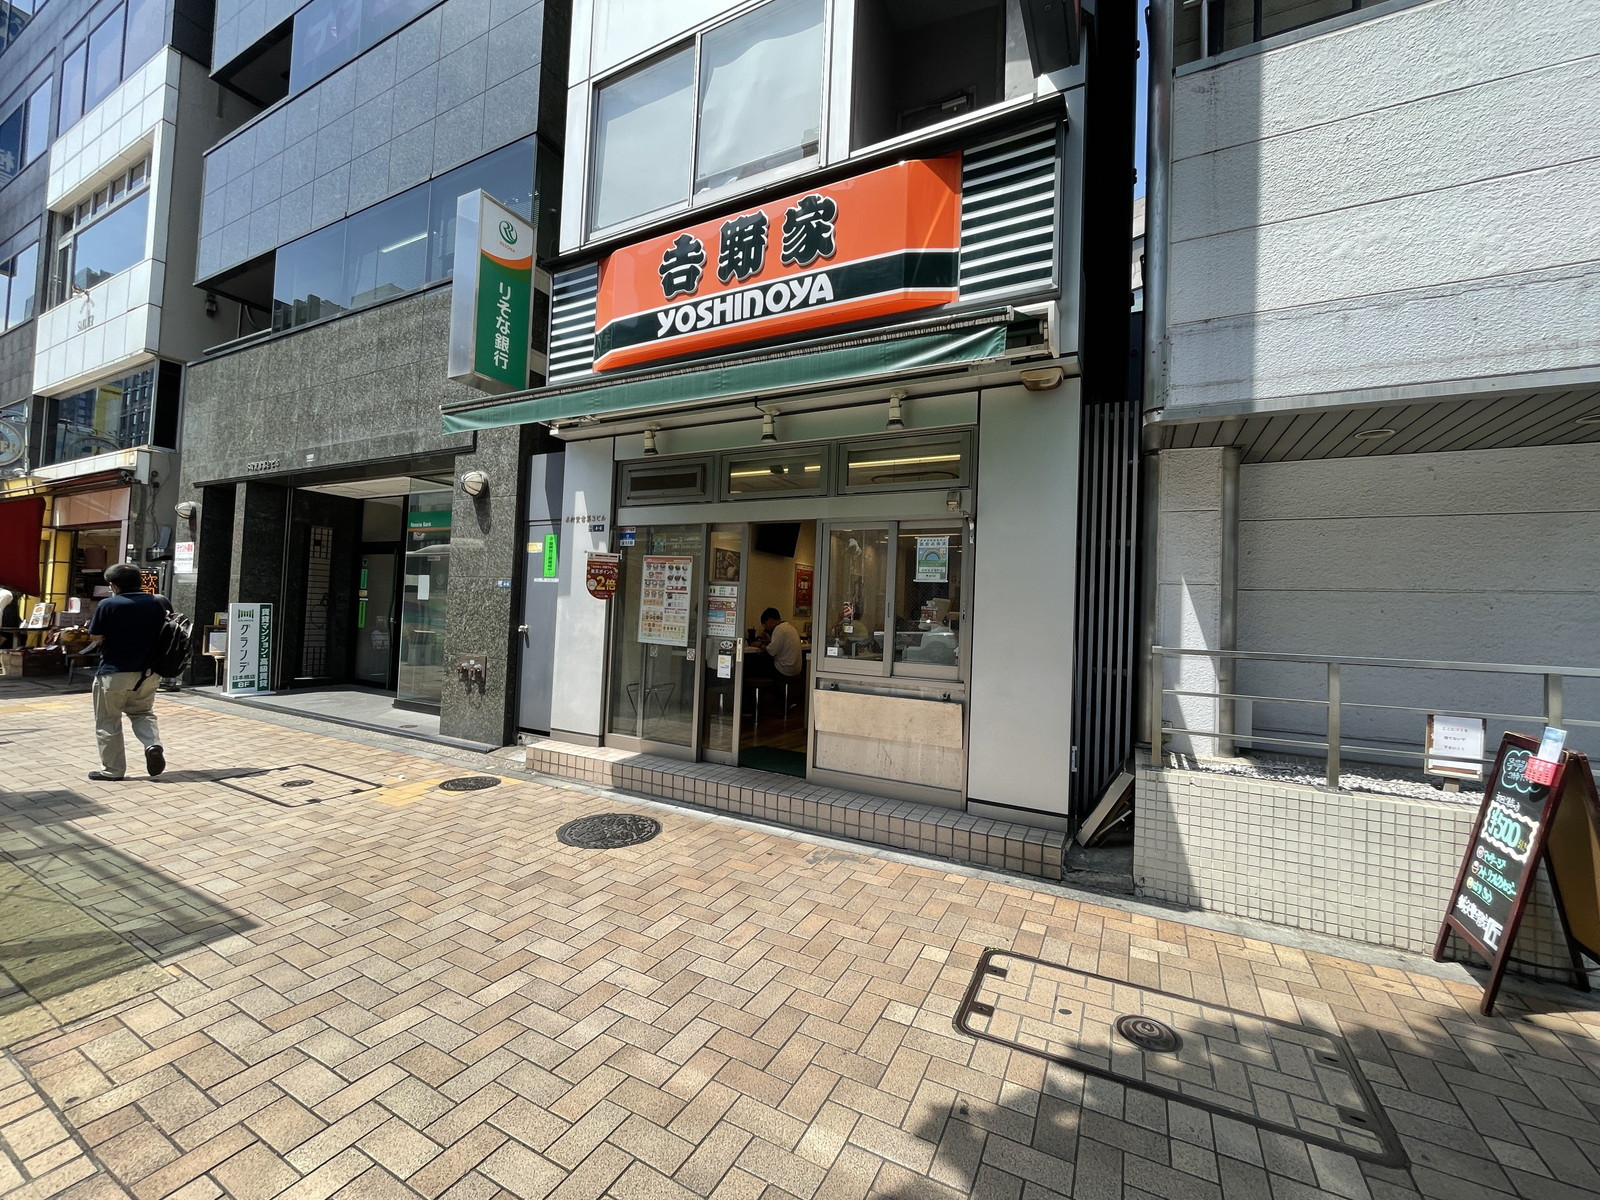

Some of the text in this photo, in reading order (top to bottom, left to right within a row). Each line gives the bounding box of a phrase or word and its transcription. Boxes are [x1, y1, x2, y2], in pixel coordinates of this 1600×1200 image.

[499, 240, 516, 253] RESONA
[658, 193, 838, 300] 吉野家
[493, 282, 512, 370] りそな銀行
[657, 273, 834, 338] YOSHINOYA
[239, 624, 251, 673] グランデ
